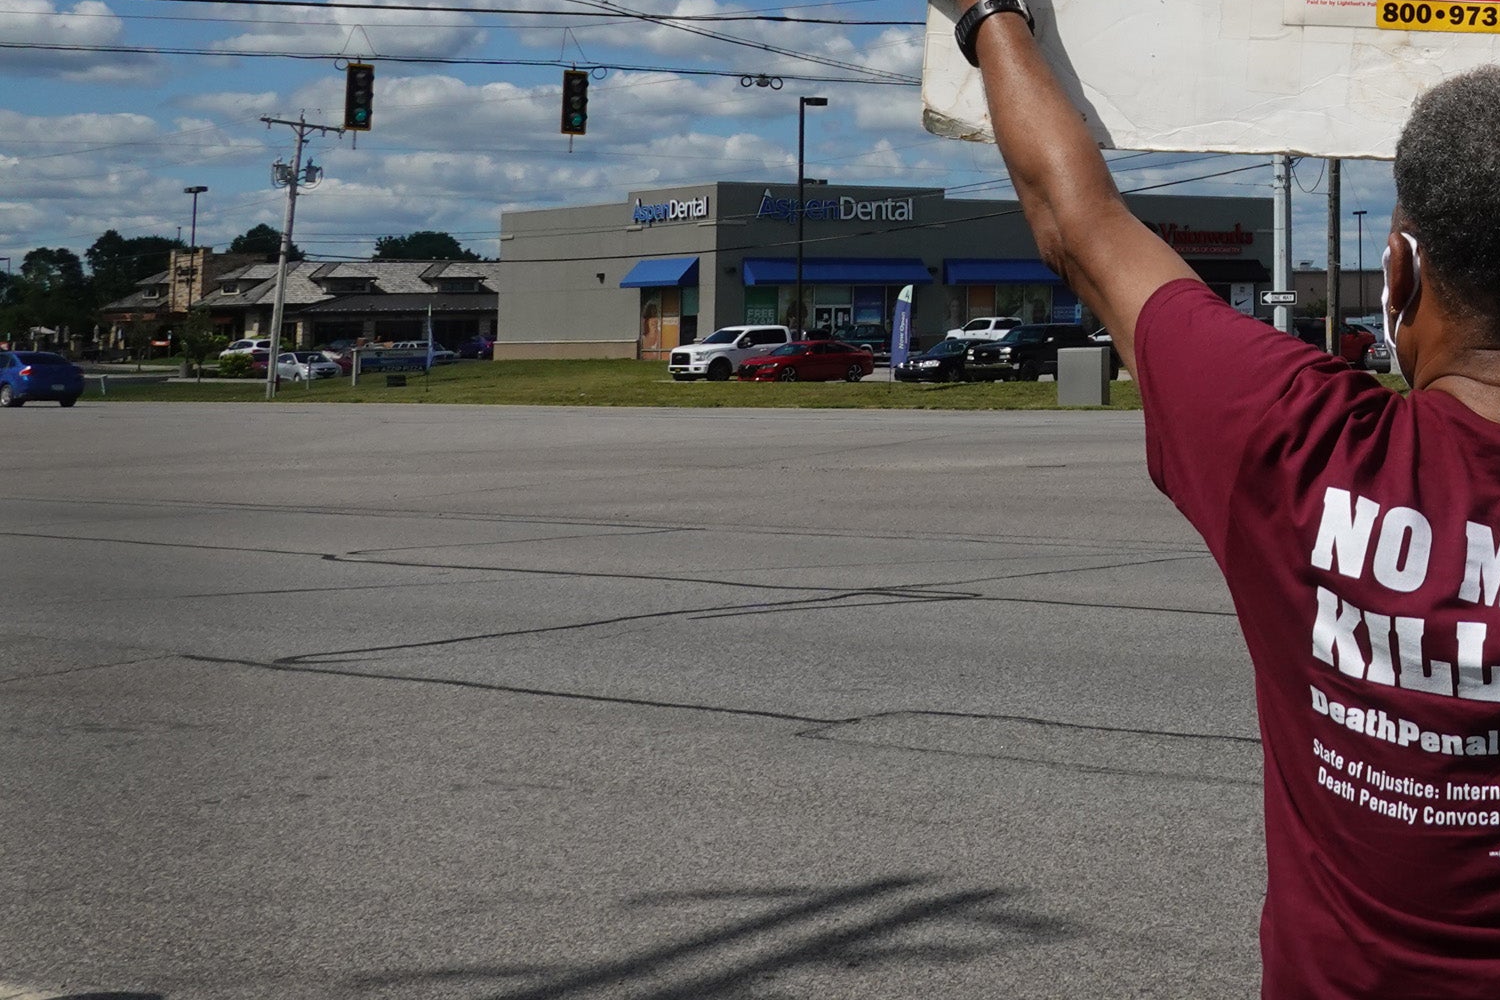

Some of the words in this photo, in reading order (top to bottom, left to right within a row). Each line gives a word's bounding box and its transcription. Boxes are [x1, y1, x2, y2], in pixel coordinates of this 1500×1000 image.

[1159, 222, 1254, 245] Visionworks
[747, 309, 775, 317] FREE
[1310, 486, 1433, 593] NO
[1313, 737, 1344, 773] State
[1347, 760, 1363, 779] of
[1366, 765, 1440, 800] Injustice:
[1318, 767, 1355, 801] Death
[1359, 786, 1418, 825] Penalty
